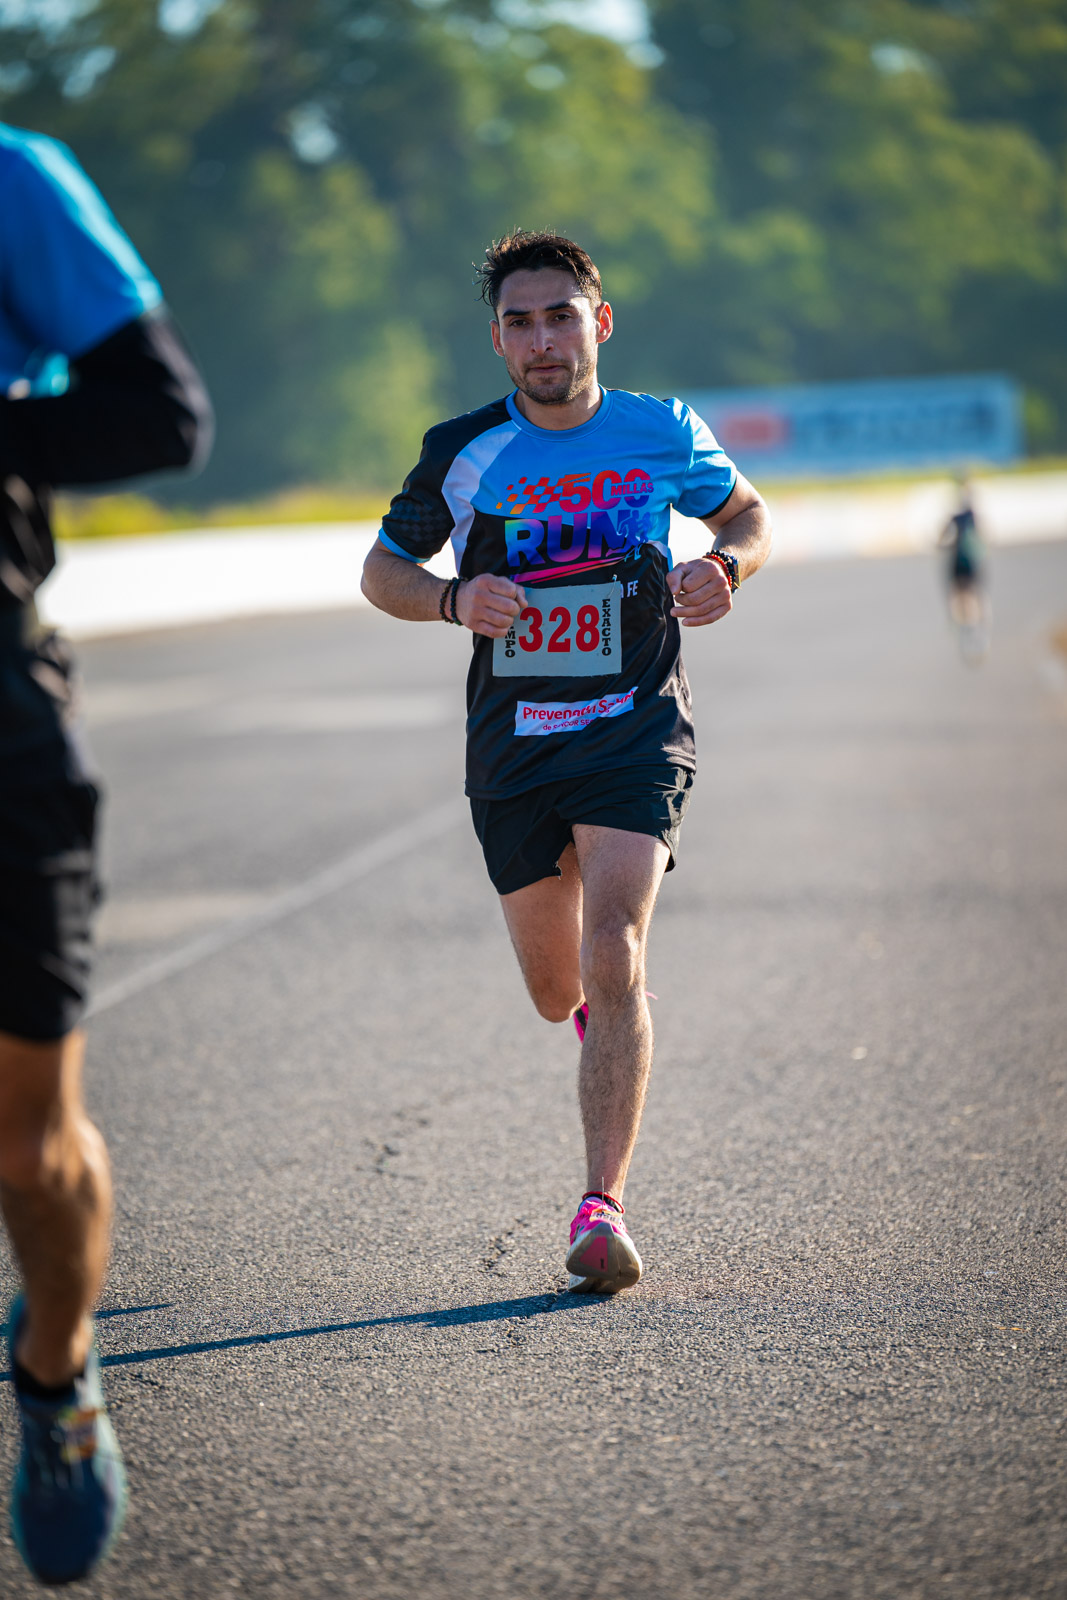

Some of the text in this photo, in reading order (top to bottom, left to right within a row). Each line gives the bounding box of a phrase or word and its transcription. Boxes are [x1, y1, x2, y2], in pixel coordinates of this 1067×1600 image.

[558, 468, 650, 514] 500
[611, 482, 654, 497] MILLAS
[505, 509, 644, 567] RUN
[627, 580, 639, 598] FE
[505, 626, 516, 658] MPO
[518, 604, 600, 653] 328
[601, 598, 612, 656] EXACTO
